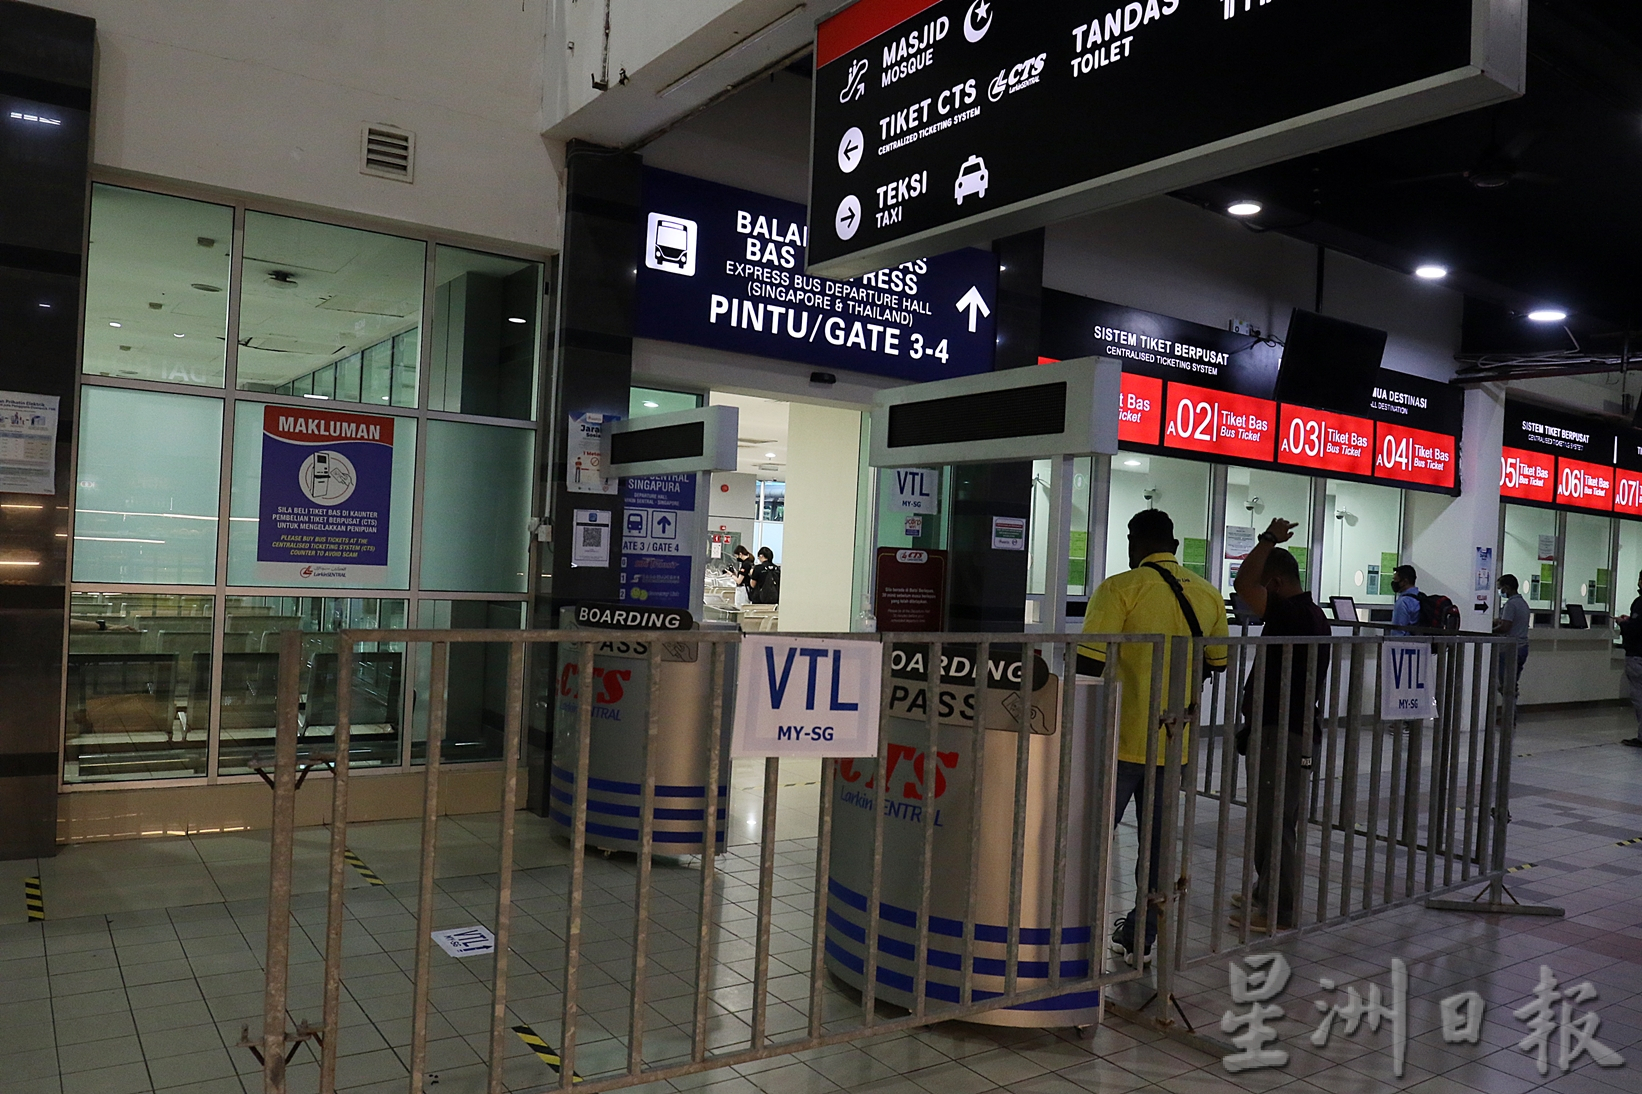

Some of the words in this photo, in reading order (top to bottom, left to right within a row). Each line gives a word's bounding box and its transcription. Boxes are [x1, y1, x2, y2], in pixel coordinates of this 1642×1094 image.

[1072, 0, 1180, 53] TANDAS
[883, 16, 949, 68] MASJID
[881, 48, 934, 88] MOSQUE
[1008, 53, 1047, 86] CTS
[1071, 36, 1133, 77] TOILET
[879, 98, 931, 140] TIKET
[937, 79, 977, 115] CTS
[878, 132, 918, 155] CENTRALIZED
[918, 117, 952, 139] TICKETING
[953, 106, 981, 126] SYSTEM
[877, 170, 927, 209] TEKSI
[736, 210, 808, 247] BALAI
[876, 205, 902, 228] TAXI
[746, 238, 795, 269] BAS
[726, 261, 790, 286] EXPRESS
[794, 274, 821, 292] BUS
[826, 281, 898, 308] DEPARTURE
[902, 301, 932, 315] HALL
[747, 281, 830, 310] (SINGAPORE
[835, 301, 843, 312] &
[847, 301, 913, 327] THAILAND)
[709, 294, 900, 356] PINTU/GATE
[909, 333, 949, 364] 3-4
[1094, 325, 1137, 346] SISTEM
[1140, 336, 1172, 353] TIKET
[1174, 343, 1229, 366] BERPUSAT
[1106, 345, 1155, 363] CENTRALISED
[1156, 356, 1191, 370] TICKETING
[1192, 363, 1218, 375] SYSTEM
[1127, 394, 1150, 411] Bas
[1389, 390, 1427, 409] DESTINASI
[279, 416, 380, 440] MAKLUMAN
[580, 424, 600, 432] Jara
[1167, 398, 1212, 441] A02
[1221, 410, 1246, 428] Tiket
[1248, 415, 1268, 431] Bas
[1522, 421, 1544, 434] SISTEM
[1545, 425, 1561, 438] TIKET
[1562, 430, 1590, 444] BERPUSAT
[1220, 425, 1235, 438] Bus
[1238, 428, 1260, 442] Ticket
[1281, 418, 1320, 457] A03
[1327, 428, 1349, 445] Tiket
[1351, 432, 1368, 447] Bas
[1326, 443, 1339, 454] Bus
[1341, 445, 1361, 457] Ticket
[1376, 435, 1408, 470] A04
[1414, 444, 1433, 459] Tiket
[1434, 447, 1449, 462] Bas
[1413, 458, 1425, 467] Bus
[1426, 460, 1444, 471] Ticket
[1519, 463, 1535, 476] Tiket
[1536, 467, 1548, 479] Bas
[628, 478, 680, 493] SINGAPURA
[897, 470, 930, 497] VTL
[1557, 468, 1580, 498] A06
[1585, 475, 1597, 487] Tiket
[1598, 478, 1609, 489] Bas
[1615, 479, 1636, 506] A07
[902, 500, 921, 508] MY-SG
[300, 523, 346, 531] MENGELAKKAN
[347, 525, 377, 533] PENIPUAN
[329, 517, 359, 525] BERPUSAT
[361, 518, 377, 526] (CTS)
[623, 541, 638, 550] ATE
[640, 541, 645, 550] 3
[652, 542, 672, 552] GATE
[674, 543, 679, 552] 4
[579, 607, 680, 629] BOARDING
[765, 646, 858, 711] VTL
[1391, 648, 1424, 689] VTL
[889, 685, 975, 720] PASS
[1399, 699, 1418, 709] MY-SG
[777, 726, 834, 741] MY-SG
